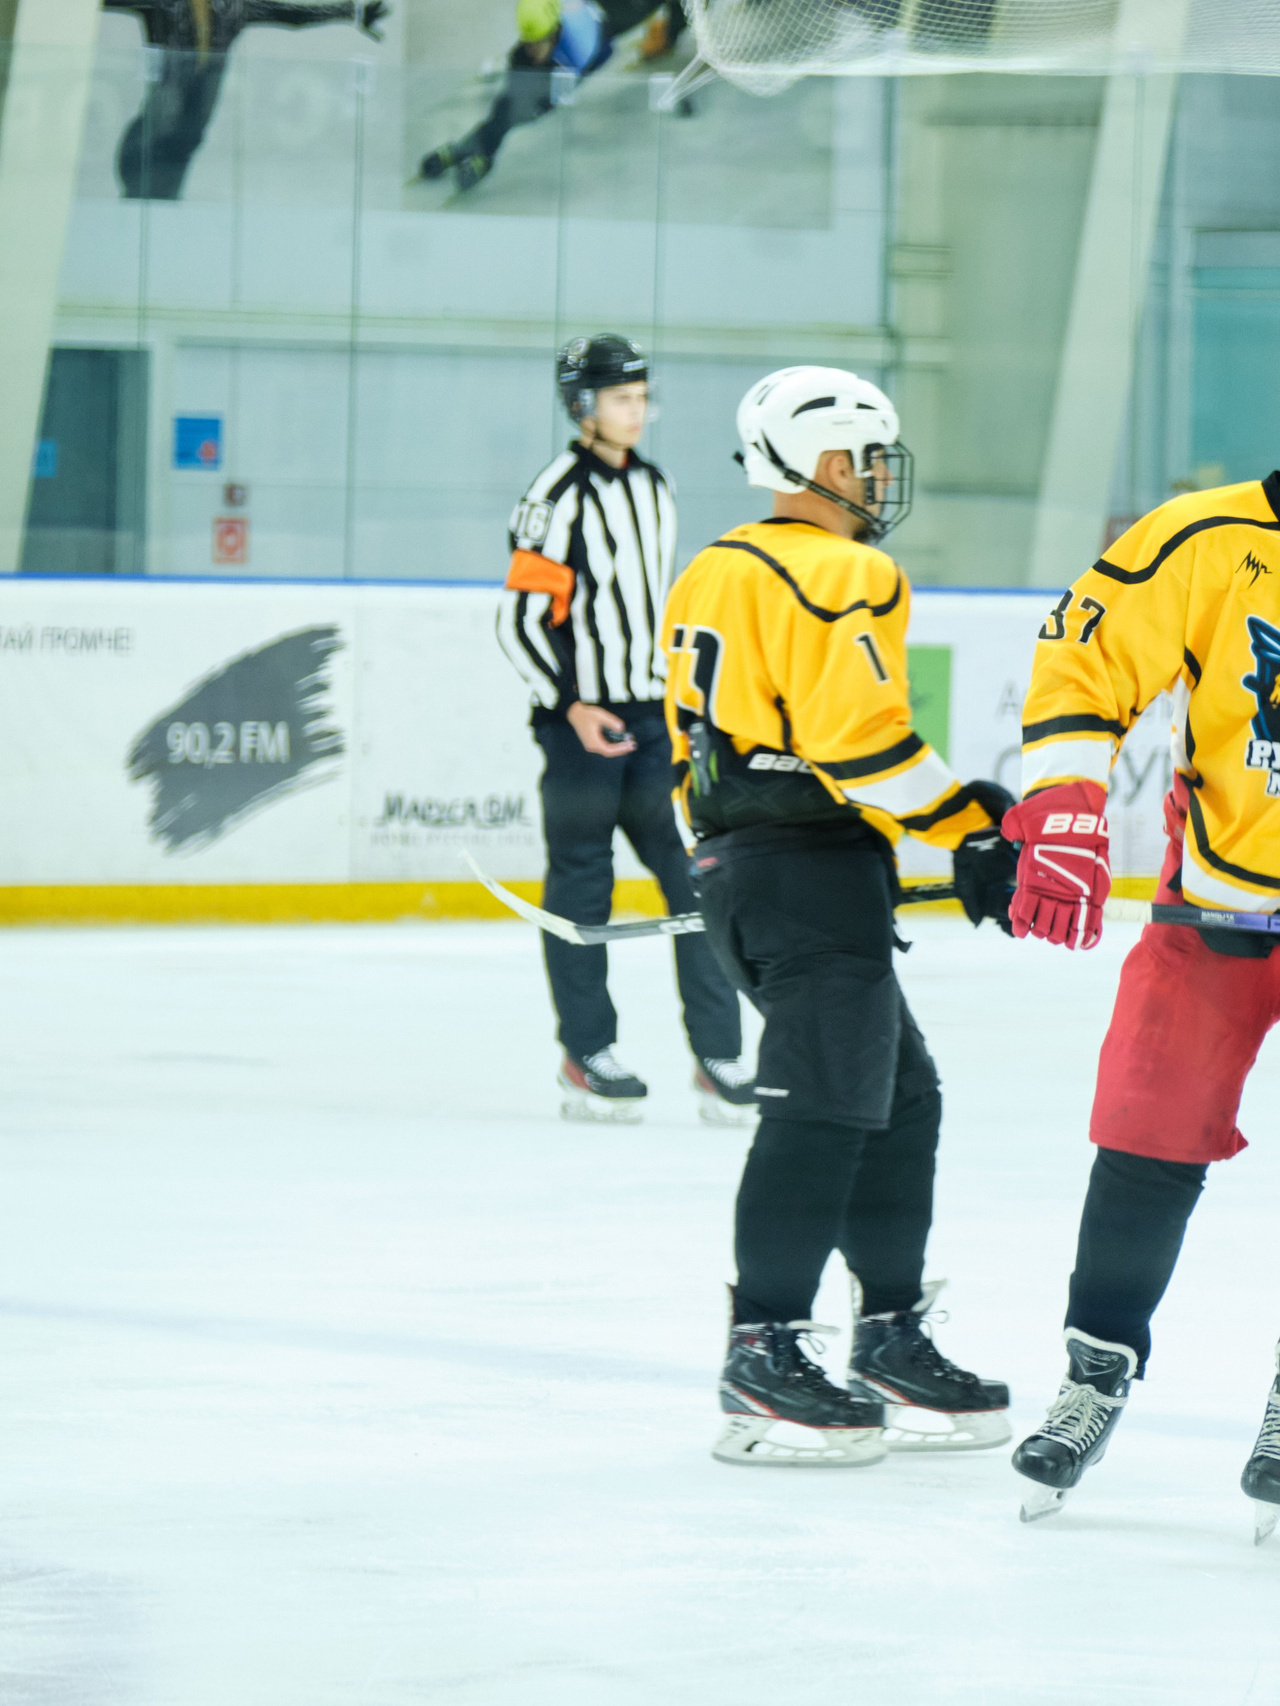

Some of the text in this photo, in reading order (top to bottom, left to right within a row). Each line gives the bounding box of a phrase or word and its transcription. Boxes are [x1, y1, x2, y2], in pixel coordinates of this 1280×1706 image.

[1037, 588, 1107, 645] 37
[854, 631, 891, 685] 1
[166, 720, 290, 769] 90,2 FM
